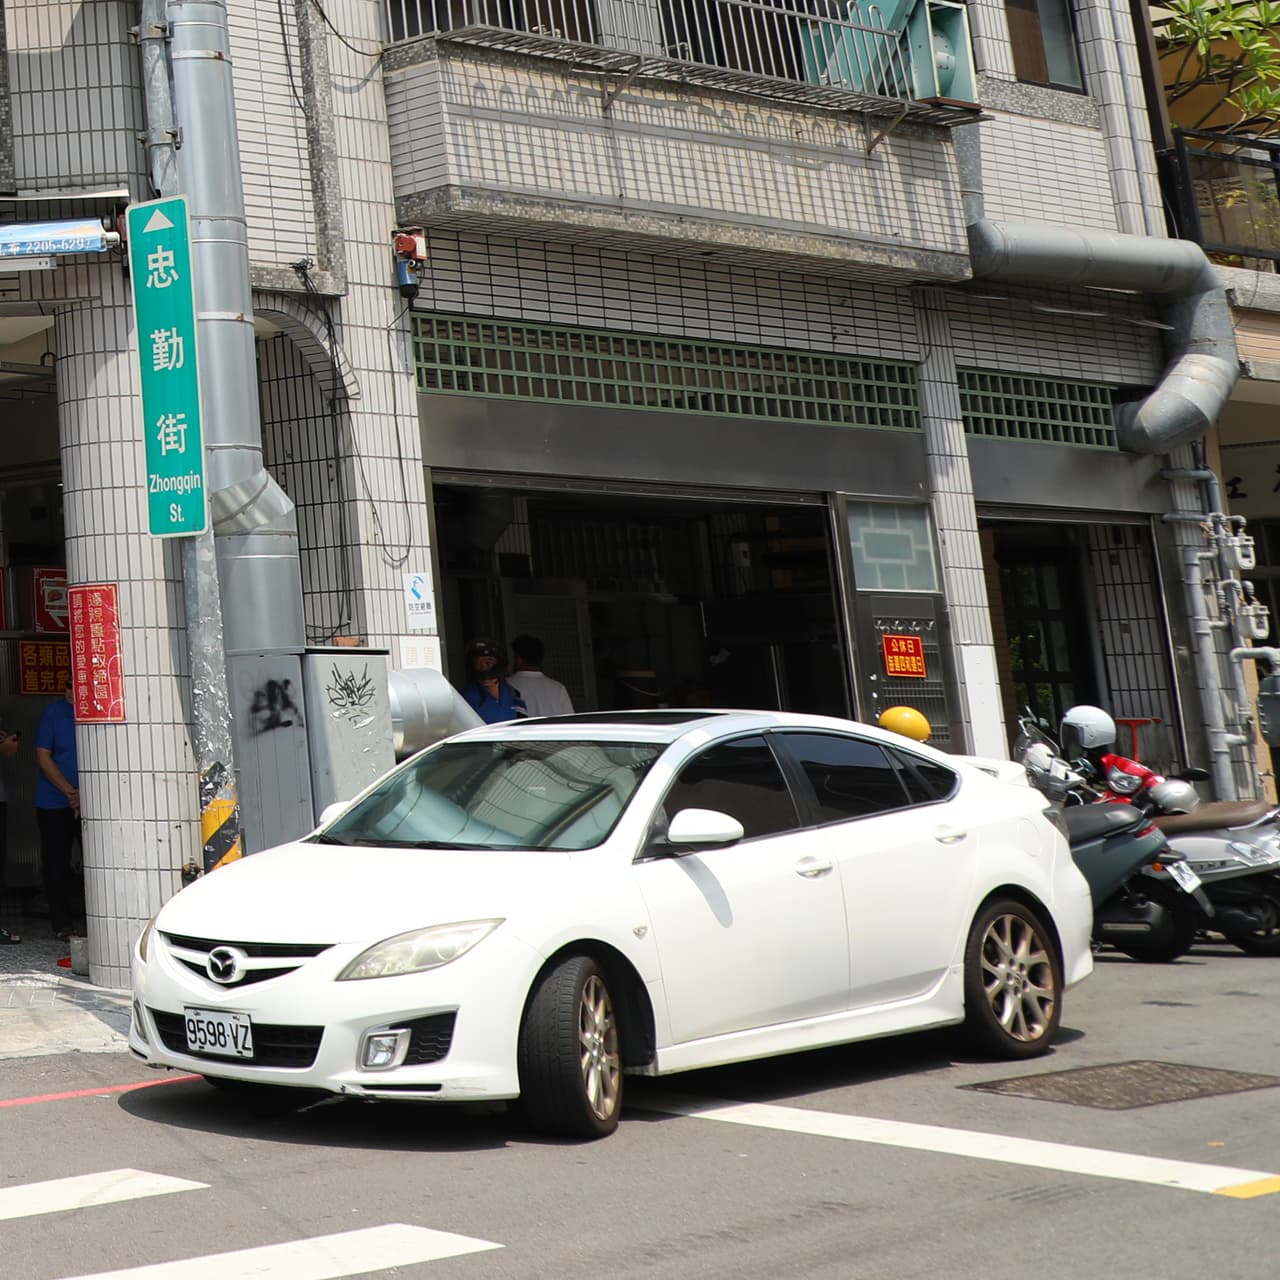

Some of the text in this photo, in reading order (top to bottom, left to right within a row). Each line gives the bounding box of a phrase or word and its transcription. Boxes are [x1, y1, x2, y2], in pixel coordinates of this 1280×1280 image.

[146, 245, 187, 456] 忠勤街
[150, 471, 201, 495] Zhongqin
[170, 503, 184, 522] St.
[891, 639, 915, 653] 公休日
